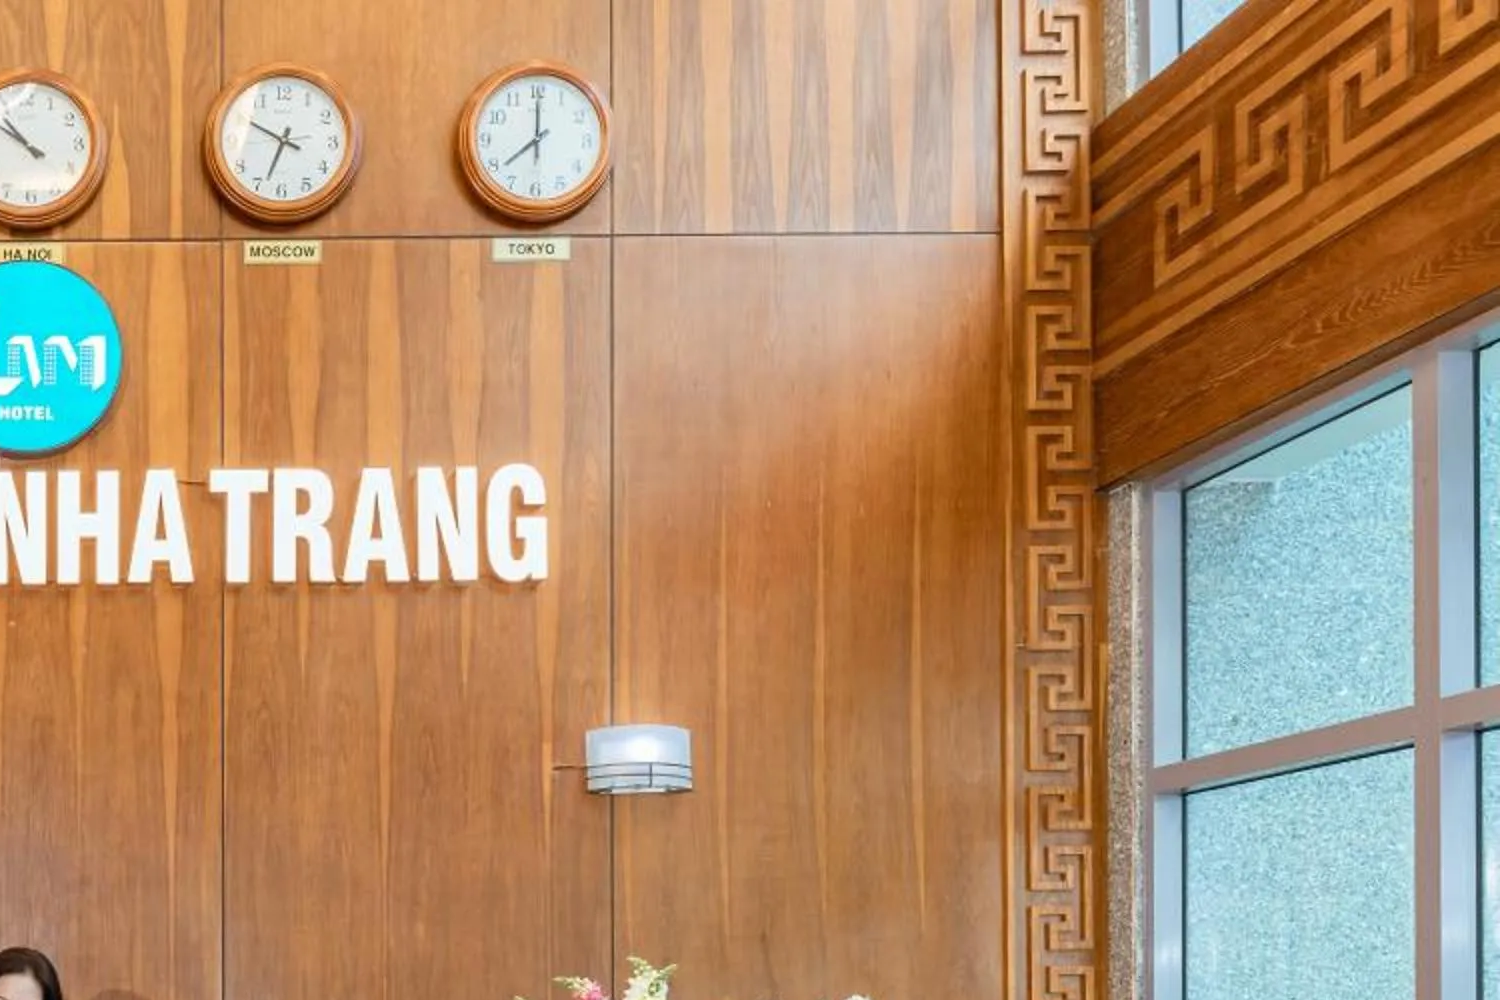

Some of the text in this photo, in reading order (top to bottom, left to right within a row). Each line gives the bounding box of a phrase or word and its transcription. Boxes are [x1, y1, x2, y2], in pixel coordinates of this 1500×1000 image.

[276, 85, 292, 101] 12
[304, 92, 310, 108] 1
[506, 91, 520, 108] 11
[558, 90, 565, 107] 1
[46, 96, 54, 112] 1
[64, 111, 76, 127] 2
[320, 109, 332, 126] 2
[489, 109, 507, 126] 10
[73, 135, 85, 152] 3
[327, 135, 340, 150] 3
[479, 131, 492, 149] 9
[318, 159, 329, 175] 4
[487, 158, 500, 173] 8
[251, 176, 263, 192] 7
[301, 177, 312, 193] 5
[504, 174, 517, 191] 7
[529, 182, 542, 198] 6
[275, 183, 288, 199] 6
[249, 245, 315, 258] MOSCOW
[508, 243, 555, 255] TOKYO
[208, 464, 549, 583] TRANG
